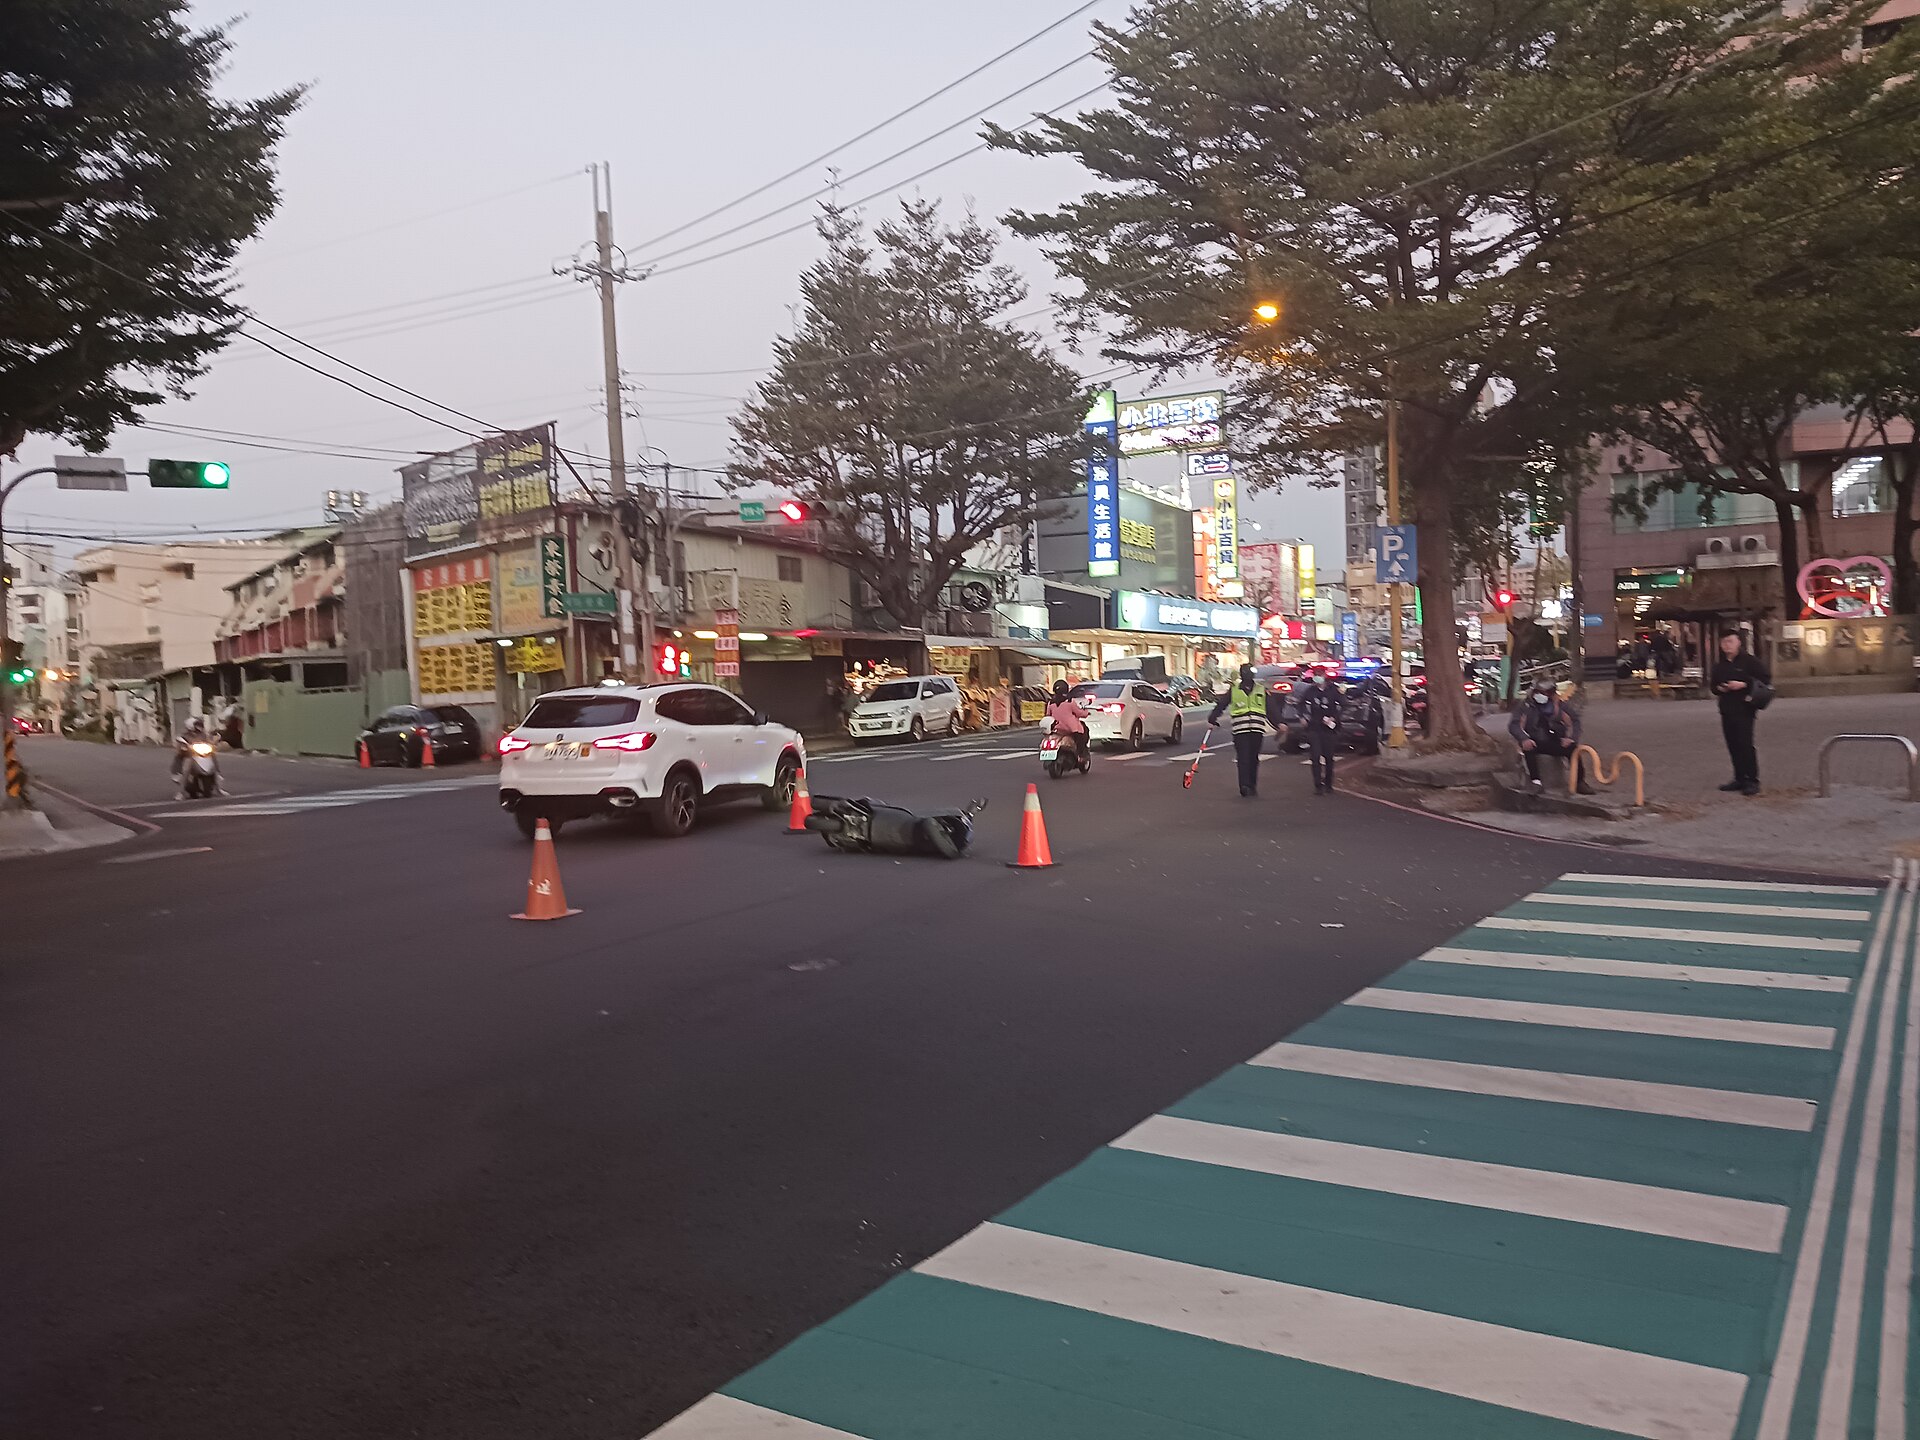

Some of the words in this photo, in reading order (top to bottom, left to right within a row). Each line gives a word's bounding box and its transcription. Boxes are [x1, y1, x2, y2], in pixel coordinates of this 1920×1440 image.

[1217, 500, 1234, 565] 小北百貨
[1382, 535, 1404, 561] P
